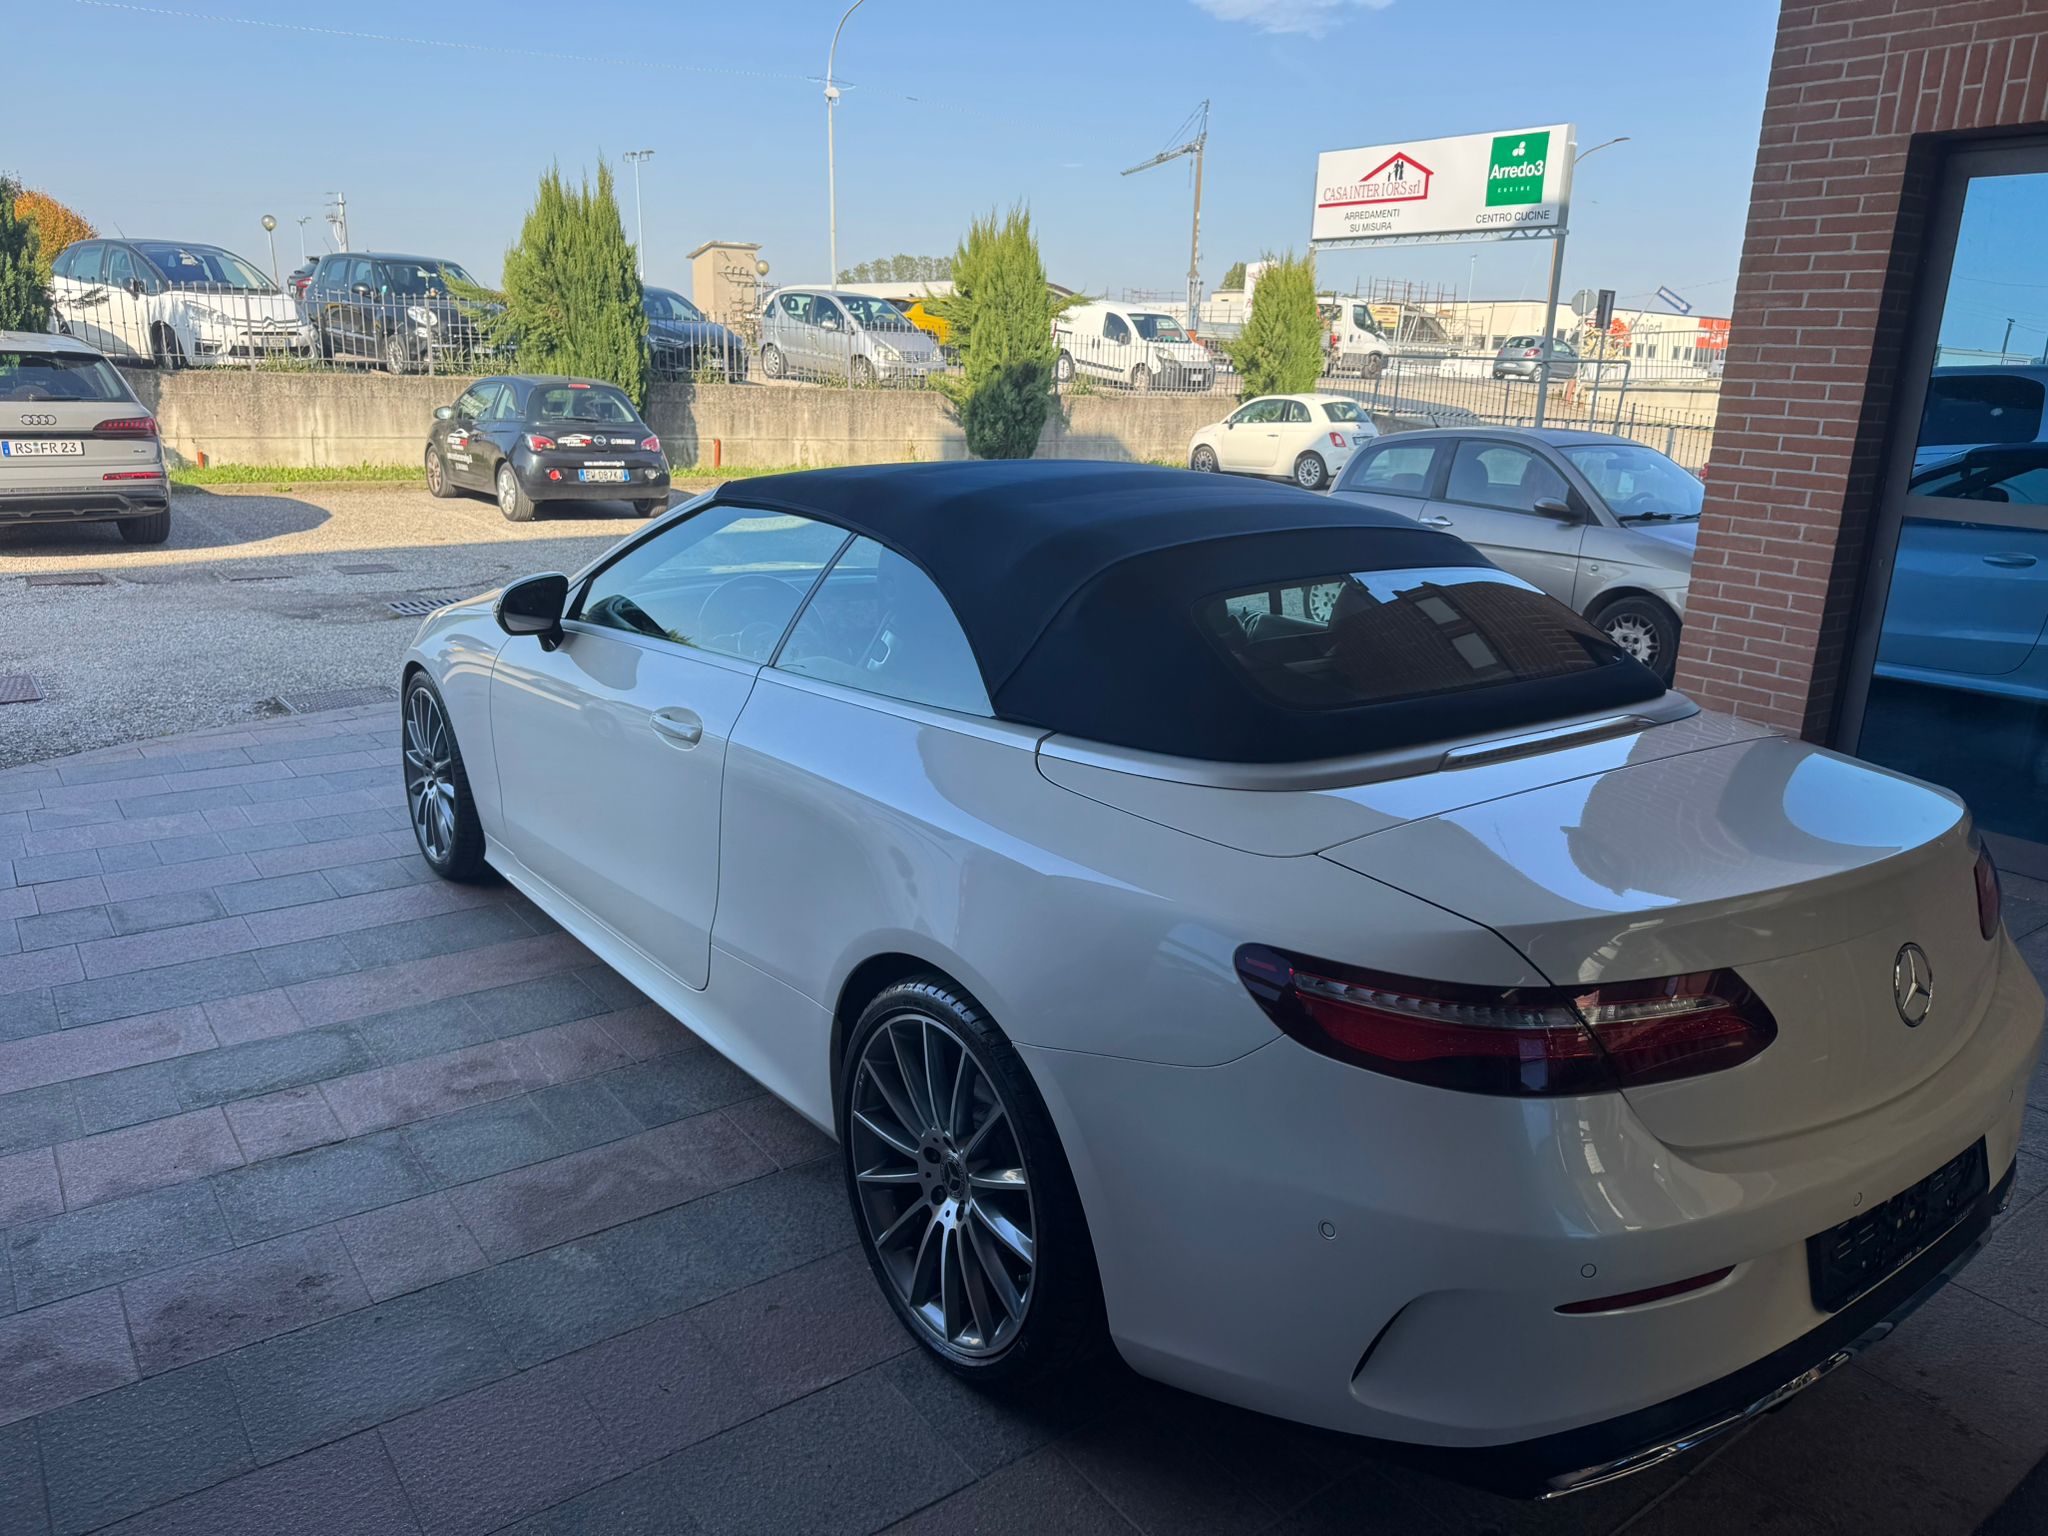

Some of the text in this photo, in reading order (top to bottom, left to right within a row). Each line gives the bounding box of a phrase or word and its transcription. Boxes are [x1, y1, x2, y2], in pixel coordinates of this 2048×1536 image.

[1489, 160, 1544, 180] Arredo3
[1408, 180, 1421, 195] srl
[1344, 208, 1401, 221] ARREDAMENTI
[1475, 210, 1551, 224] CENTRO CUCINE
[1349, 221, 1393, 233] SU MISURA
[15, 441, 77, 454] RS FR 23
